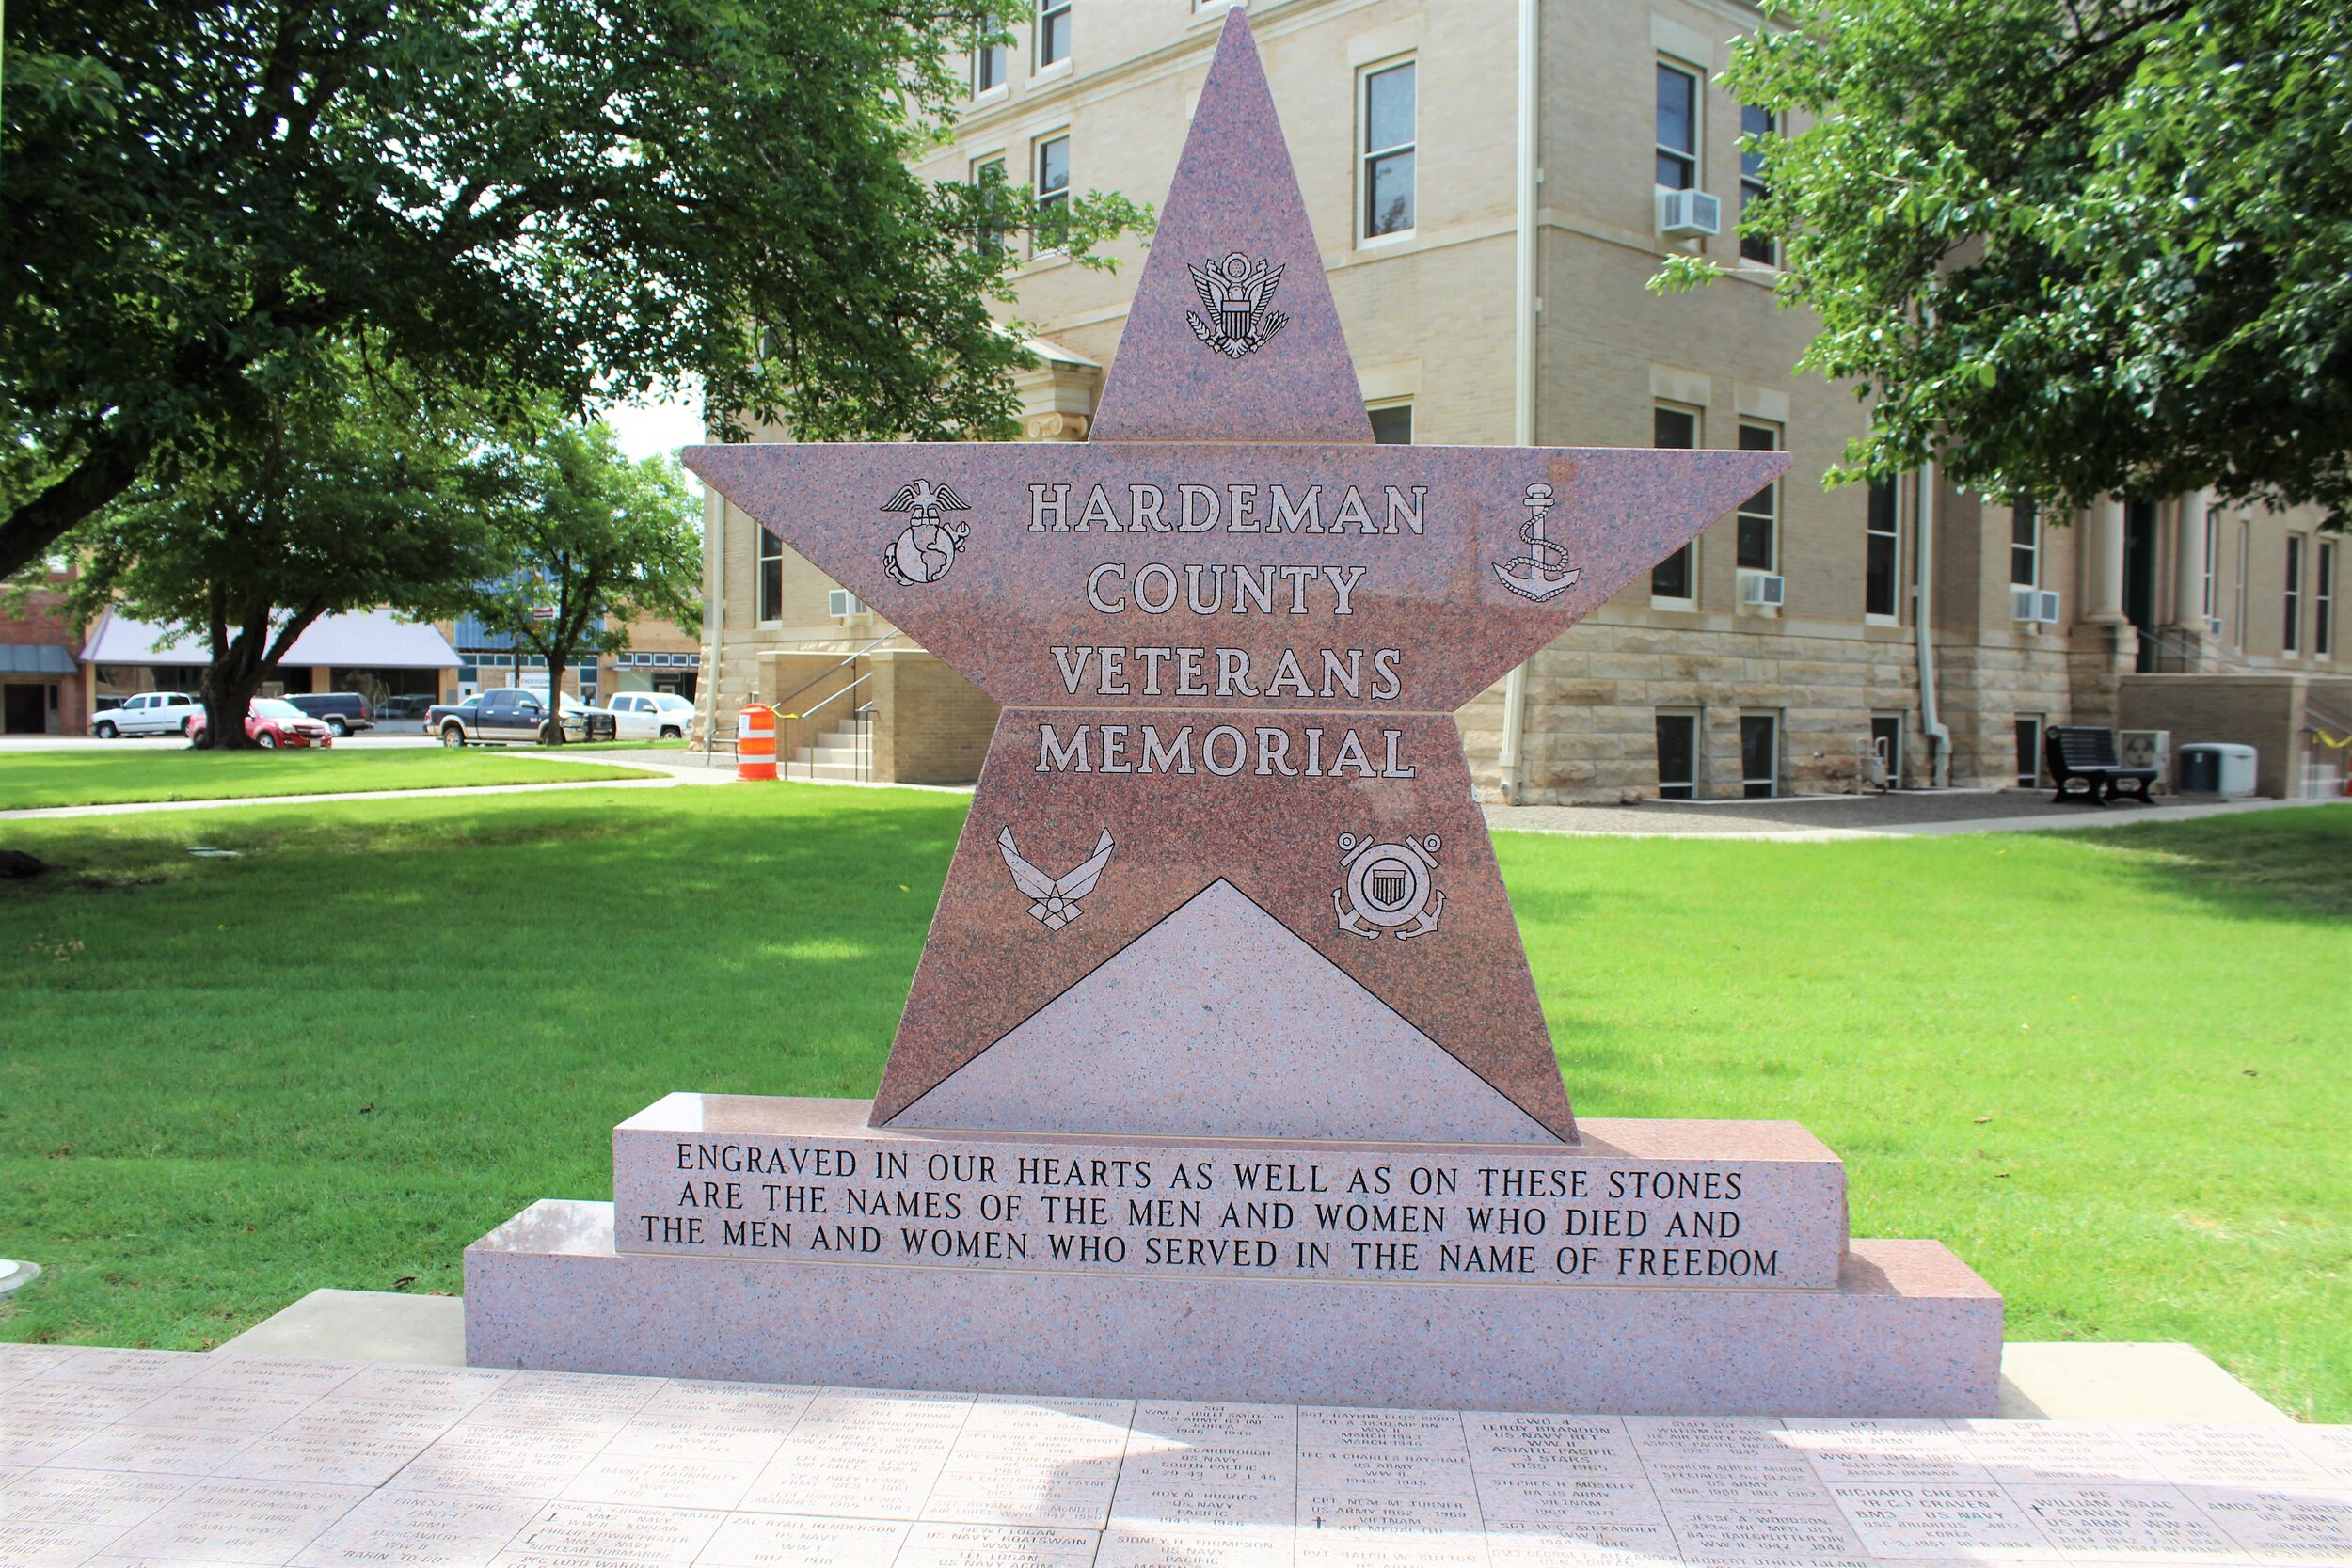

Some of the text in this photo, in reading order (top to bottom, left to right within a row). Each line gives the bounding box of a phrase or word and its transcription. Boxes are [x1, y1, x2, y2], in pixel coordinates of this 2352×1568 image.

[1028, 483, 1427, 534] HARDEMAN
[1087, 563, 1366, 615] COUNTY
[1051, 645, 1402, 700] VETERANS
[1035, 723, 1416, 779] MEMORIAL
[676, 1144, 1742, 1200] ENGRAVED IN OUR HEARTS AS WELL AS ON THESE STONES
[678, 1182, 1740, 1239] ARE THE NAMES OF THE MEN AND WOMEN WHO DIED AND
[641, 1216, 1779, 1277] THE MEN AND WOMEN WHO SERVED IN THE NAME OF FREEDOM
[1184, 1447, 1271, 1456] SCARBROUGH
[1491, 1446, 1550, 1455] ASIATIC
[1204, 1492, 1258, 1500] HUGHES
[1836, 1488, 2001, 1497] RICHARD CHESTER
[393, 1497, 444, 1507] ERNEST
[468, 1503, 503, 1512] PRICE
[1411, 1500, 1463, 1509] TURNER
[1919, 1500, 1991, 1509] CRAVEN
[2034, 1499, 2111, 1508] WILLIAM
[2208, 1502, 2258, 1511] AMOS
[672, 1511, 721, 1520] PRATER
[1855, 1511, 1897, 1519] BM3
[1958, 1512, 2006, 1520] NAVY
[2057, 1509, 2129, 1517] CRAVEN
[636, 1515, 672, 1524] NAVY
[2289, 1514, 2340, 1523] ARMY
[626, 1523, 679, 1532] KOREAN
[732, 1516, 758, 1527] ZAC
[812, 1524, 896, 1533] HENDERSON
[2141, 1520, 2180, 1528] WW
[961, 1527, 1056, 1536] NEWT LOGAN
[1575, 1525, 1657, 1533] ALEXANDER
[2327, 1525, 2342, 1533] II
[775, 1532, 839, 1543] US NAVY
[951, 1533, 989, 1542] NAVY
[1002, 1535, 1086, 1546] BOATSWAIN
[1722, 1533, 1816, 1543] RAILSPLITTER
[1117, 1536, 1172, 1544] SIDNEY
[1196, 1539, 1273, 1549] THOMPSON
[528, 1544, 671, 1560] NUCLEAR SUBMARINE
[781, 1544, 812, 1552] WW
